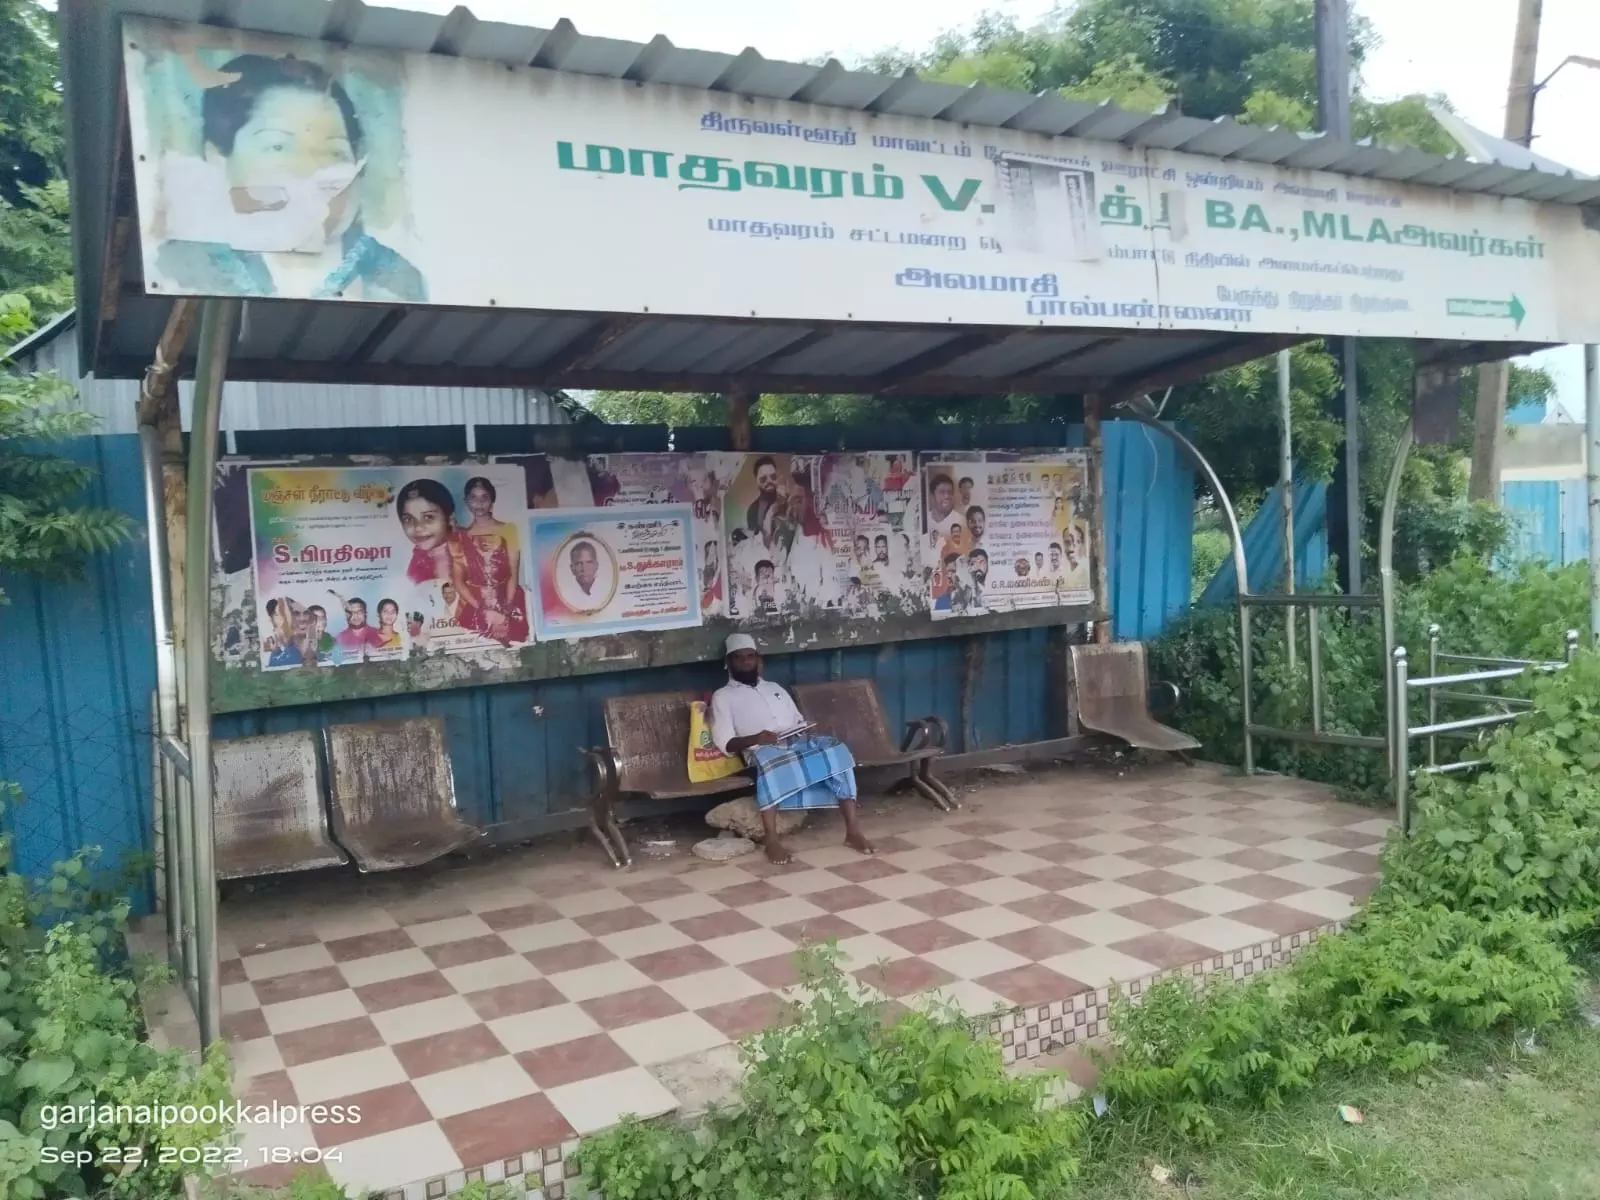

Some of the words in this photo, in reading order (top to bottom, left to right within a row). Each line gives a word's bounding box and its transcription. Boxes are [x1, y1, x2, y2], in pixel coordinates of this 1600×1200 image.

[872, 134, 972, 157] மாவட்டம்
[556, 140, 905, 201] மாதவரம்
[708, 216, 834, 241] மாதவரம்
[894, 267, 1060, 297] அலமாதி
